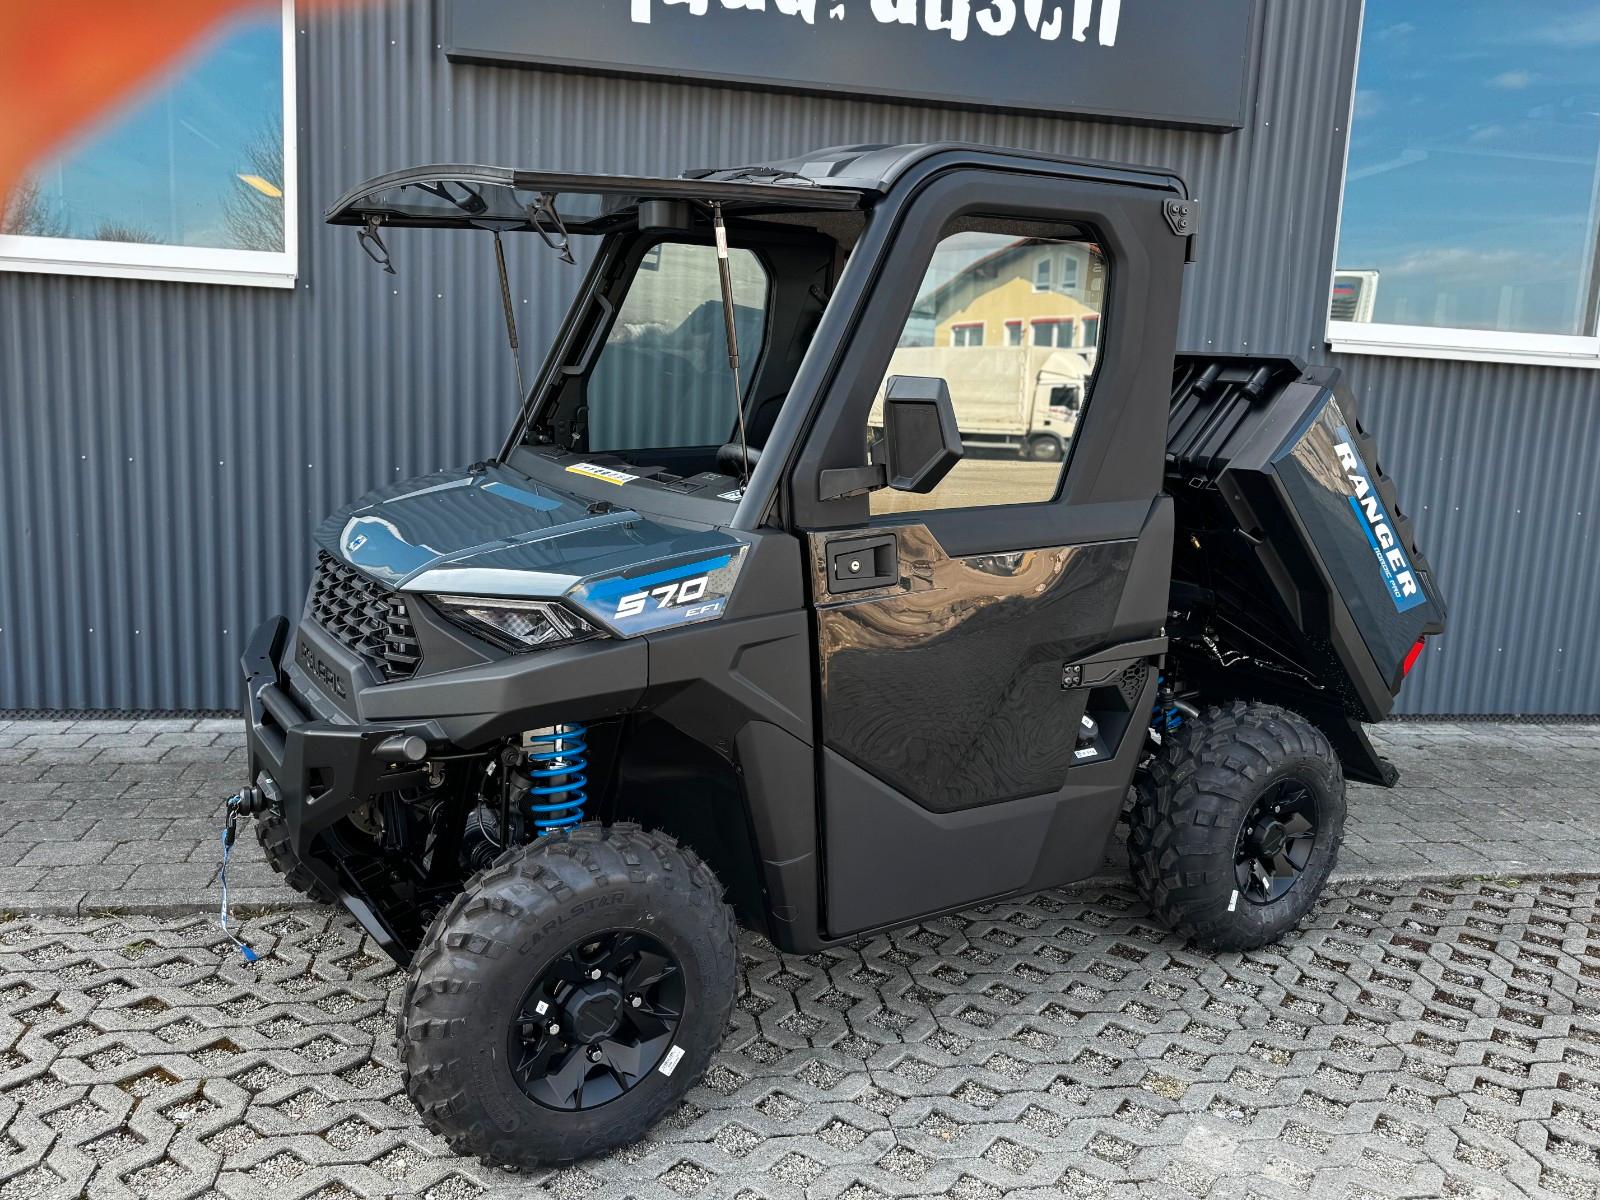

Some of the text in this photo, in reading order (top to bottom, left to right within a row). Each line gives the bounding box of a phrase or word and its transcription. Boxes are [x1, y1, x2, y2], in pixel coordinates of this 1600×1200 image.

[1334, 442, 1416, 598] RANGER
[614, 576, 708, 619] 570
[685, 602, 720, 617] EFI
[518, 892, 625, 956] CARLSTAR
